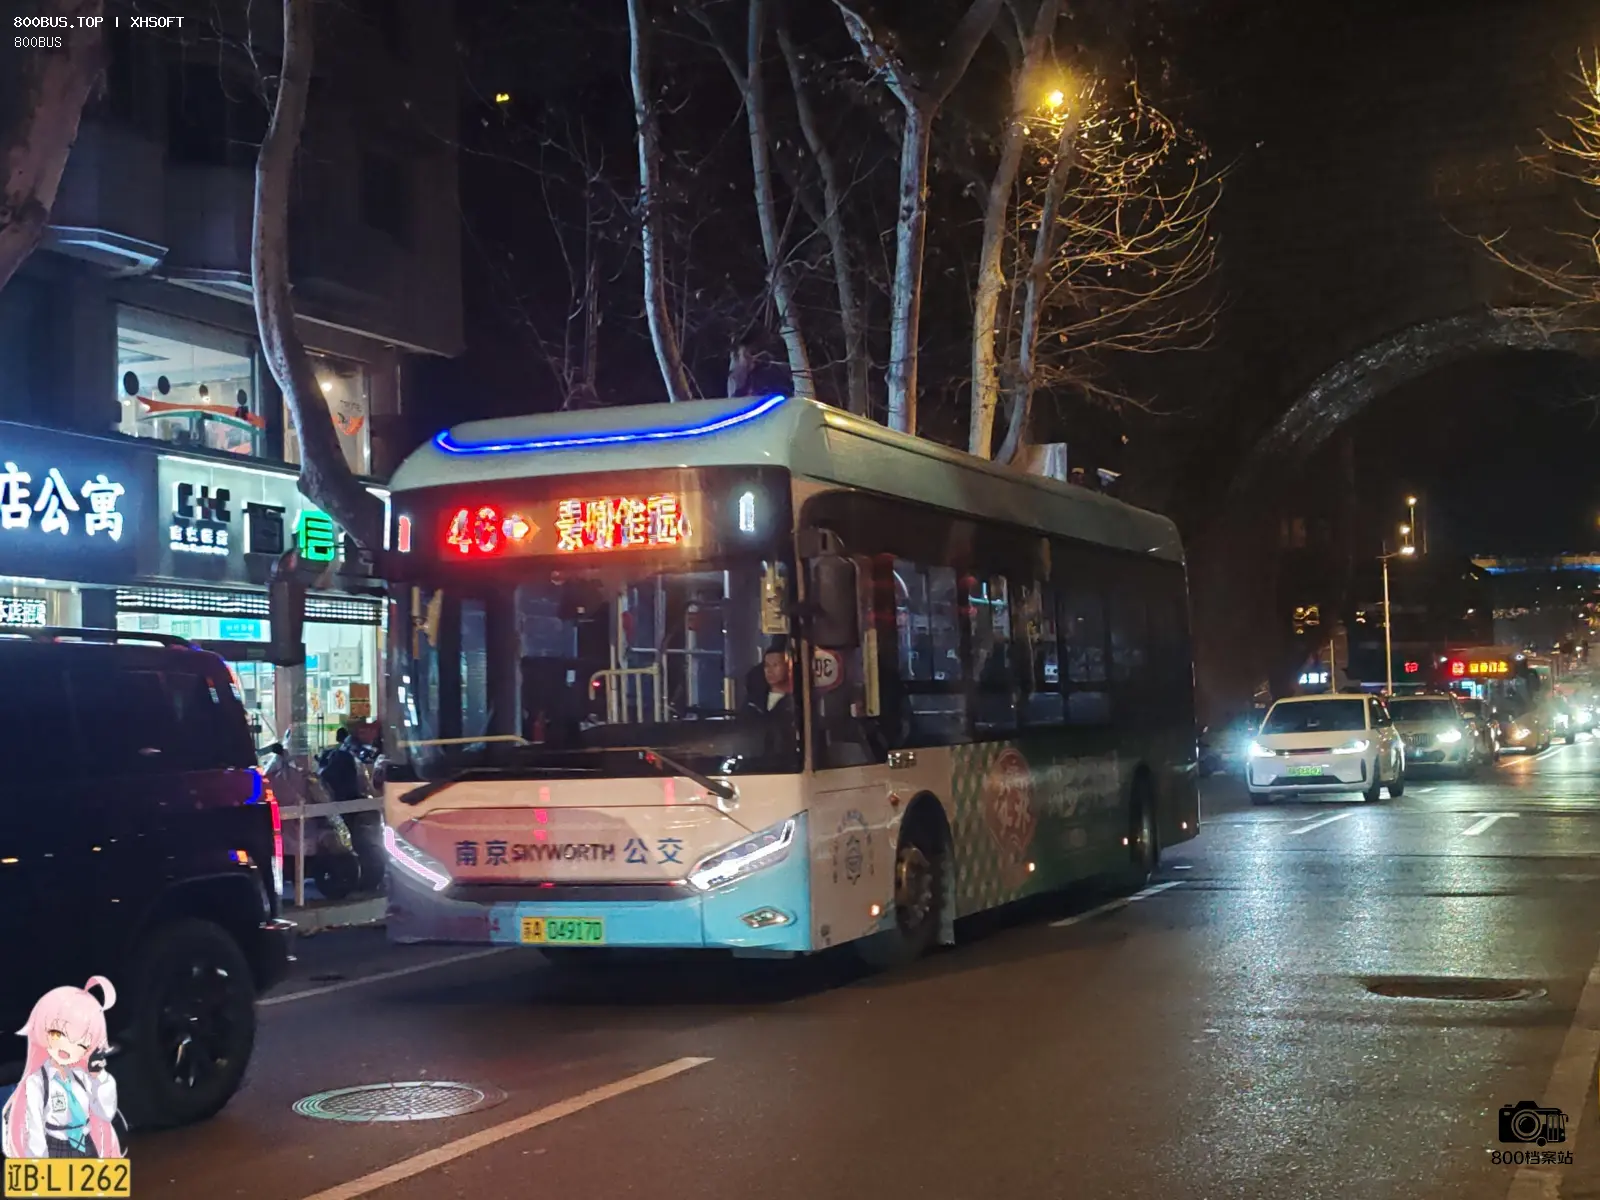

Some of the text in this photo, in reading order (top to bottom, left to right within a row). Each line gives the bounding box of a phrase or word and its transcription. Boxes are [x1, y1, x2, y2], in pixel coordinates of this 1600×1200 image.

[0, 462, 125, 541] 店公寓
[455, 838, 684, 866] 南京 SKYWORTH 公交
